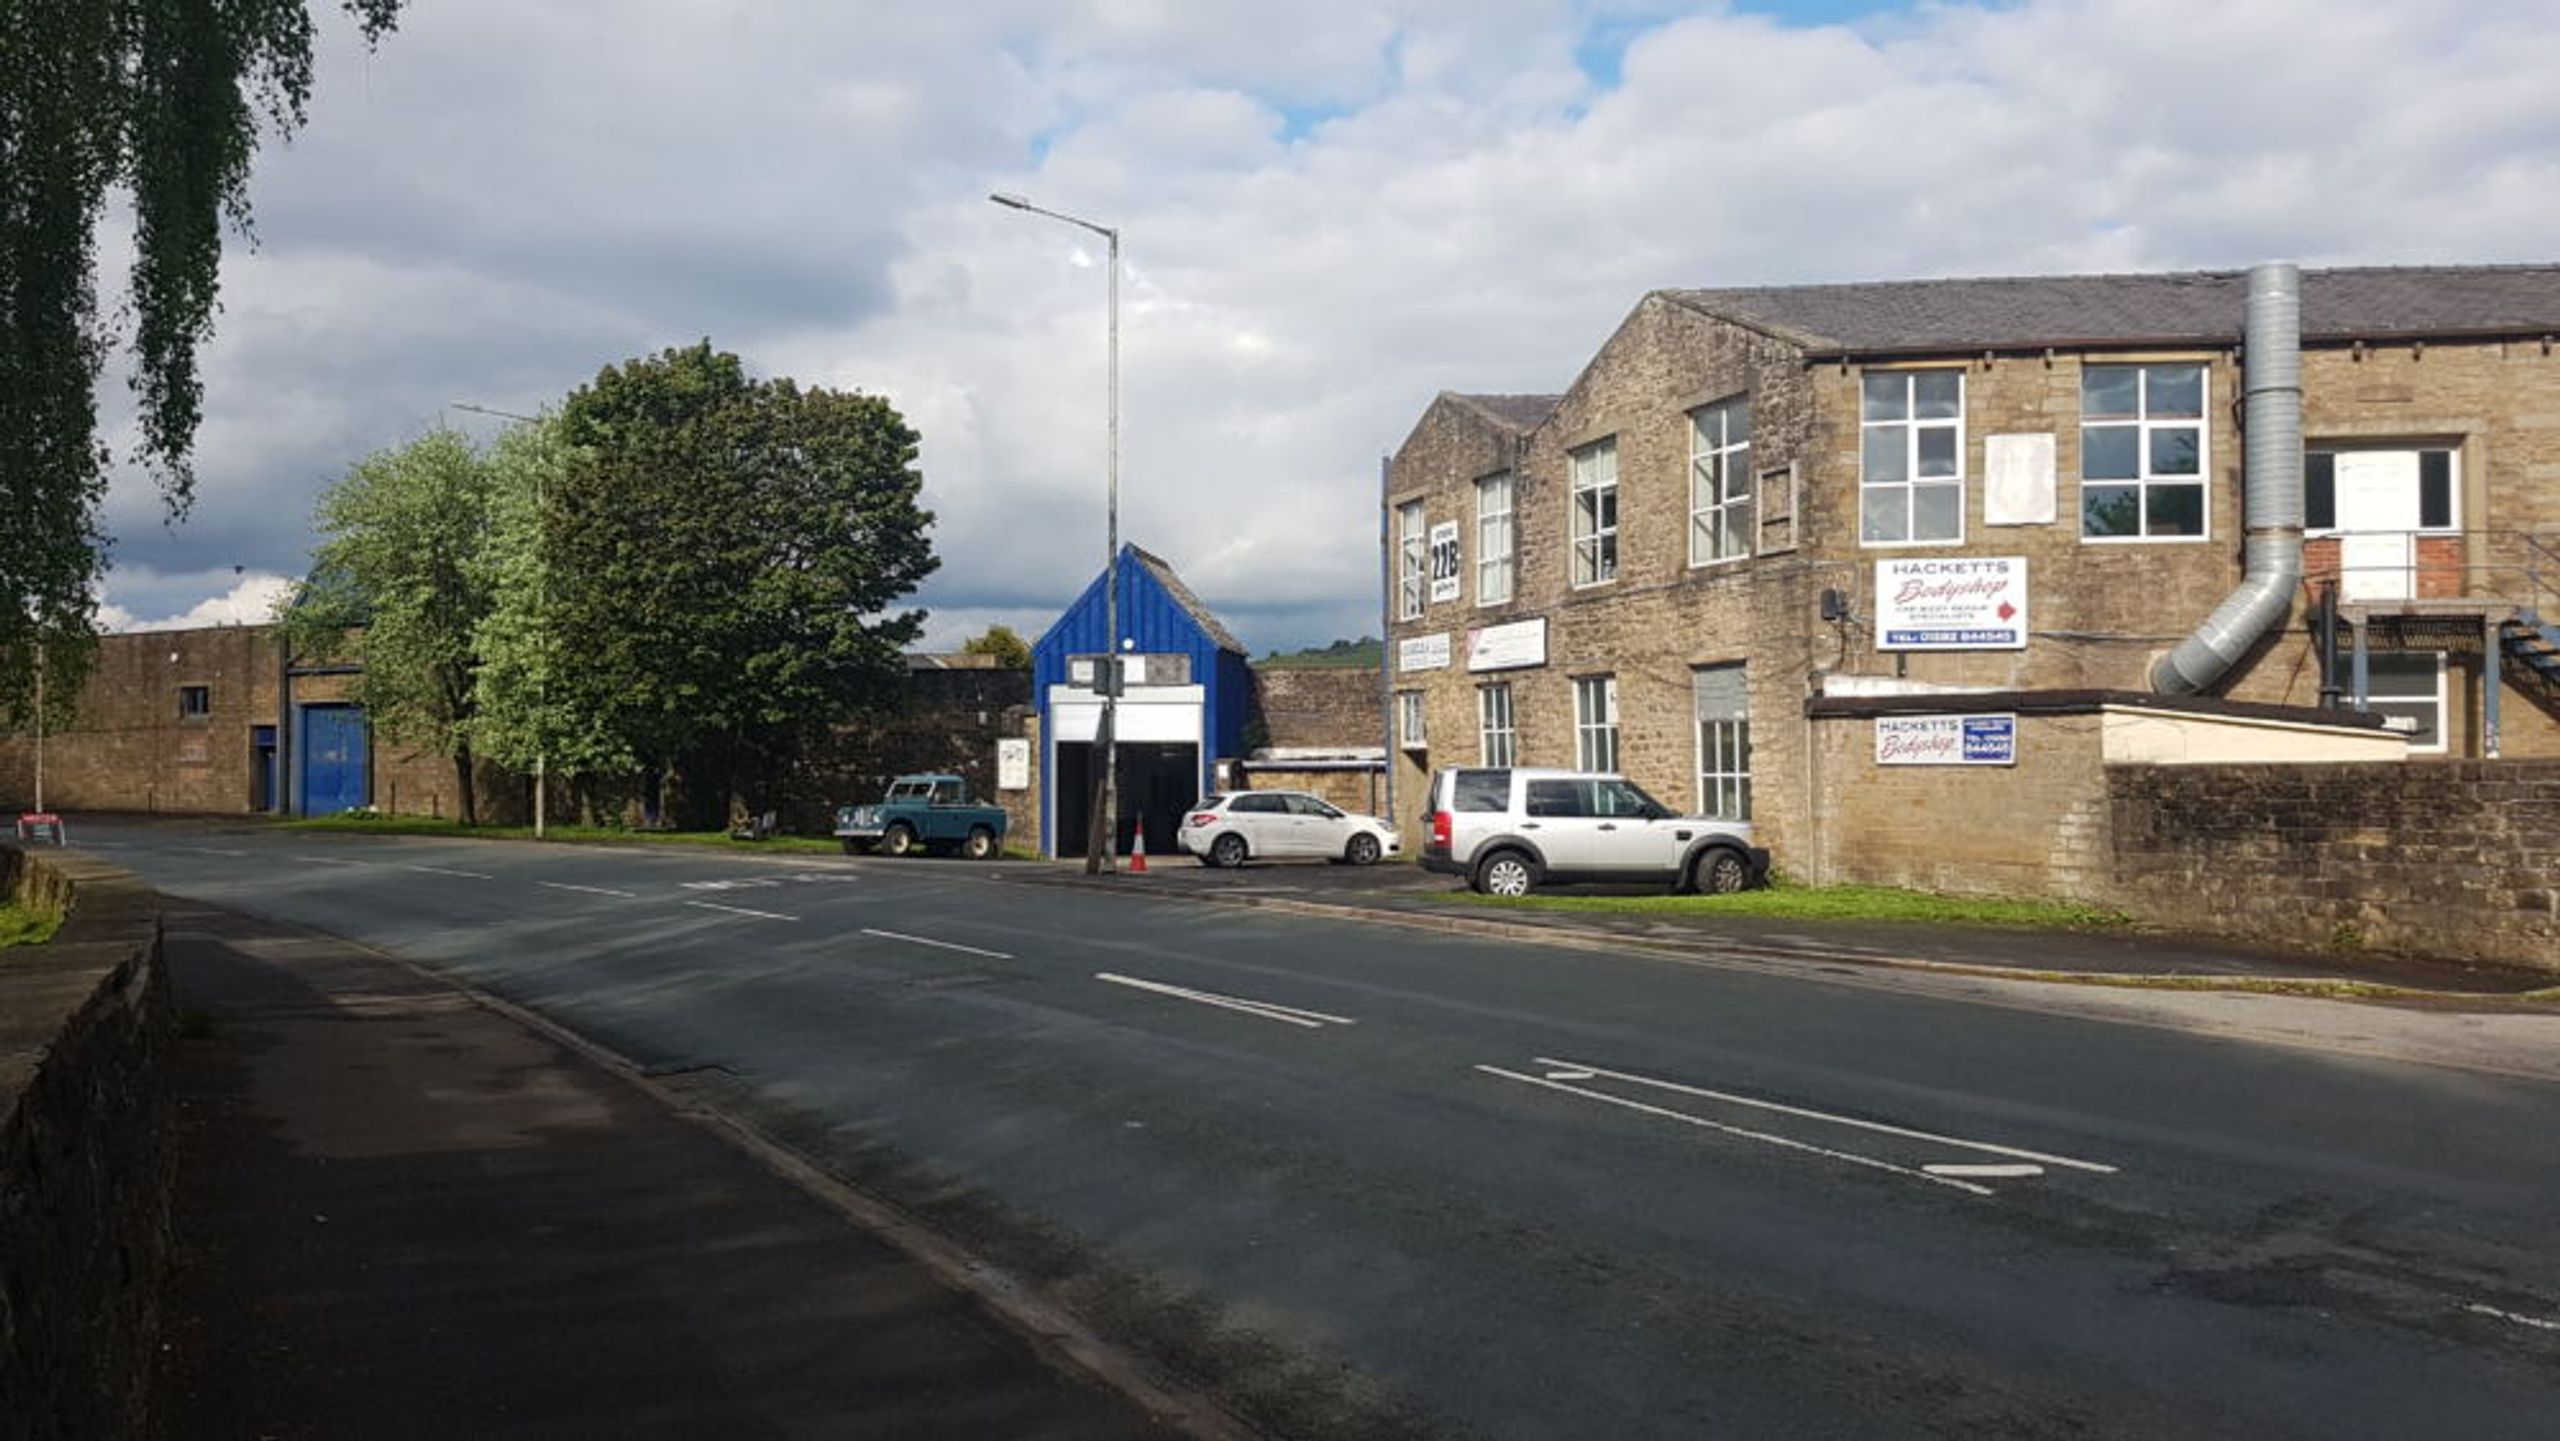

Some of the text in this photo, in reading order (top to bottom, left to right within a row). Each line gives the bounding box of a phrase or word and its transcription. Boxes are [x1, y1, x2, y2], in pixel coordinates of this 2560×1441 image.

[1893, 561, 2009, 575] HACKETTS
[1894, 576, 2008, 605] Bodyshop
[1879, 719, 1959, 732] HACKETTS
[1881, 734, 1955, 759] Bodyshop
